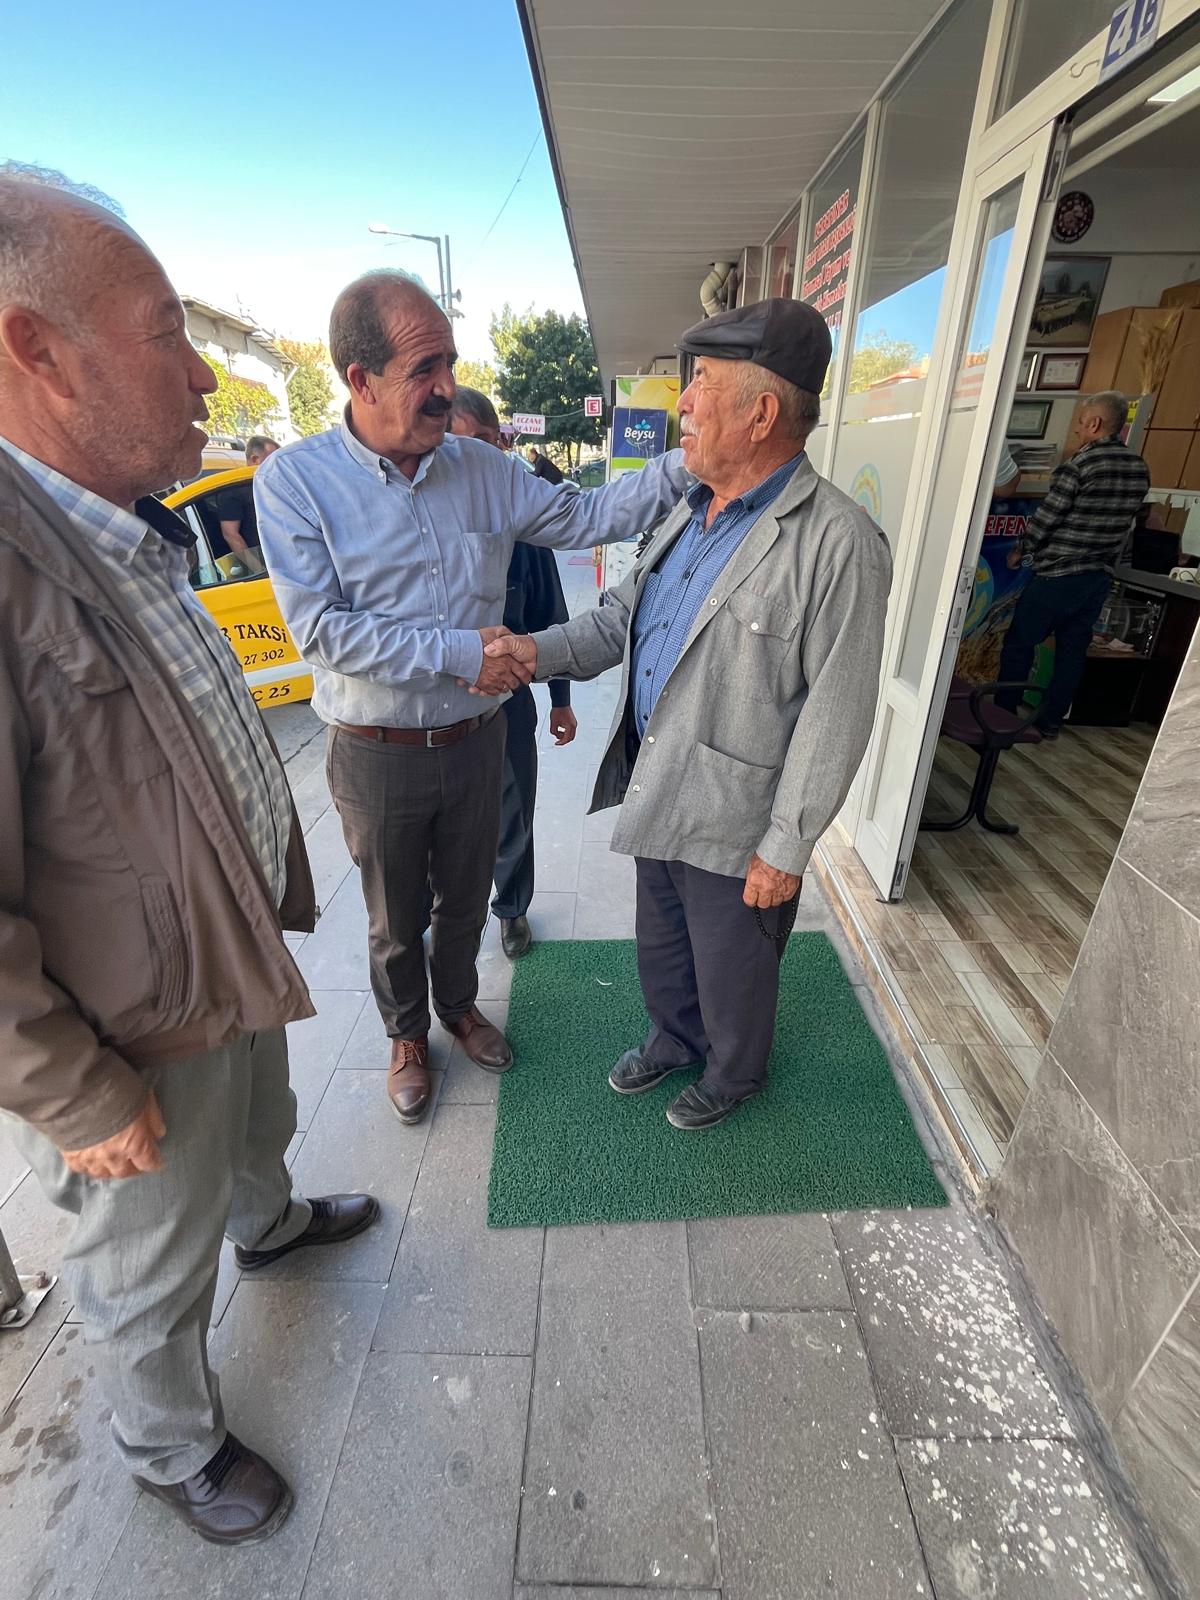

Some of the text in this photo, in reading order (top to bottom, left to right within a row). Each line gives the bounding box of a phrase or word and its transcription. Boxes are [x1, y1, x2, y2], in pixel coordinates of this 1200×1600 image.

[624, 427, 655, 441] Beysu
[244, 648, 285, 666] 27 302
[268, 684, 290, 699] 25
